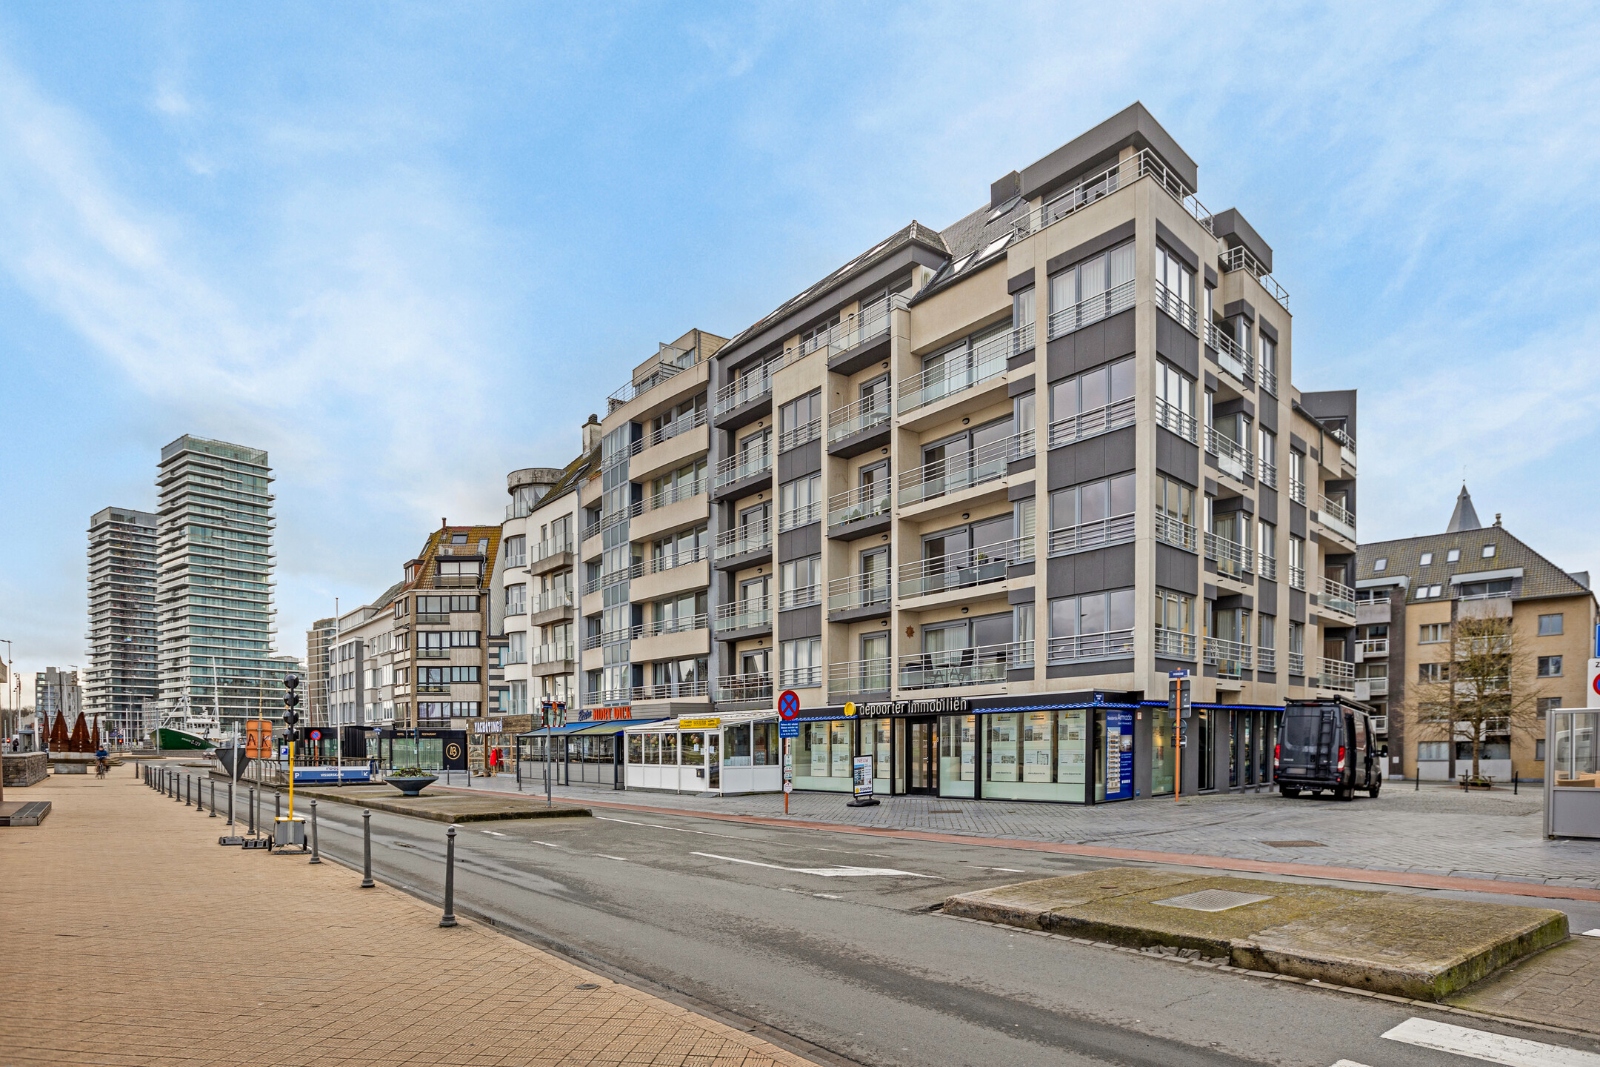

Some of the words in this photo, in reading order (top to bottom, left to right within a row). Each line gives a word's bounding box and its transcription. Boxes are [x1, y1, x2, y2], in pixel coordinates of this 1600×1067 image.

[613, 706, 632, 719] DICK
[860, 702, 905, 717] depoorter
[907, 697, 967, 714] immobiliën
